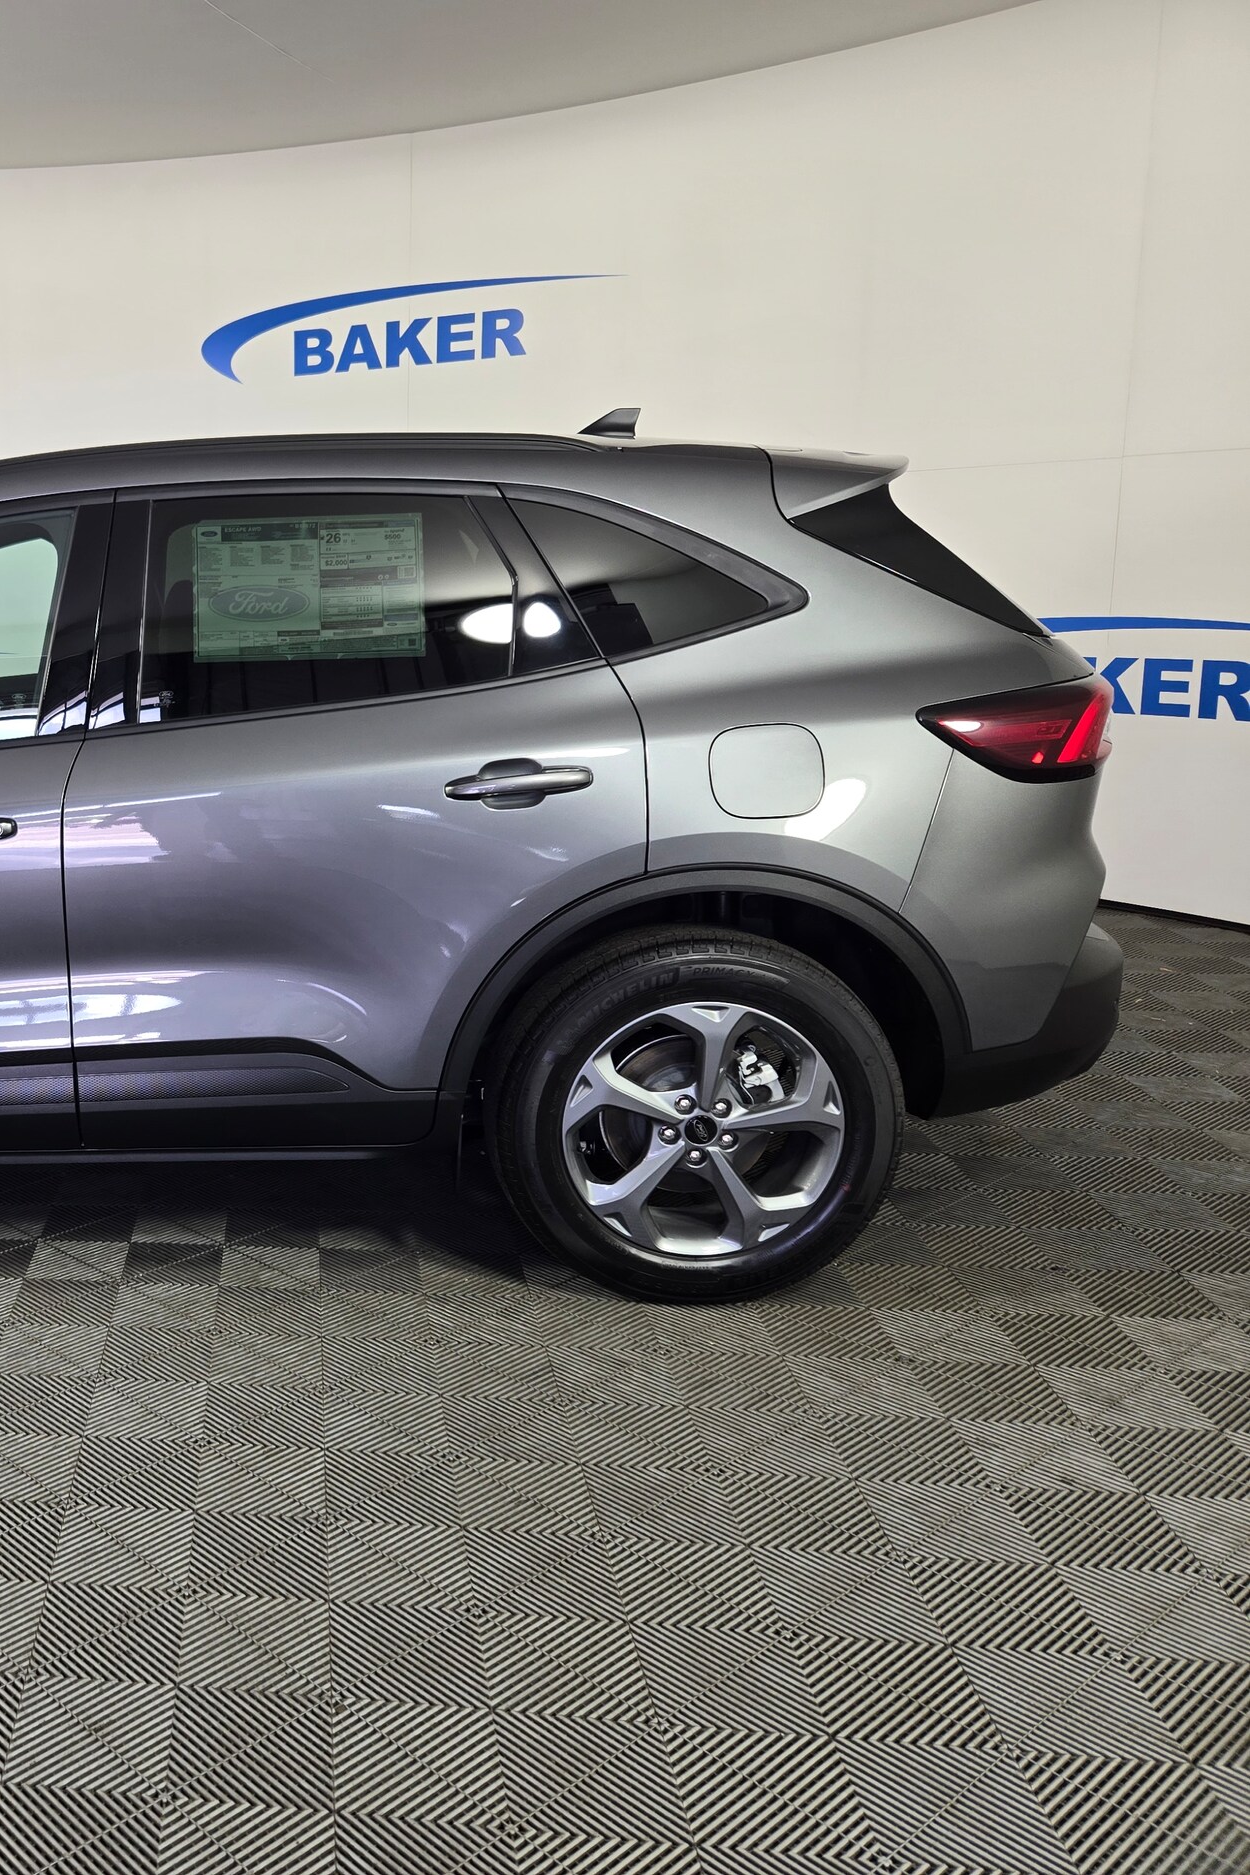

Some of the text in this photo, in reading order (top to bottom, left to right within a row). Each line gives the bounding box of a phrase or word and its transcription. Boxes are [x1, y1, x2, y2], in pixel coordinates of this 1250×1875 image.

[293, 308, 526, 377] BAKER
[325, 532, 341, 544] 26
[325, 559, 348, 567] $2,000
[229, 590, 290, 614] Ford
[1082, 656, 1250, 722] KER
[578, 965, 755, 1028] MICHELIN PRIMACY
